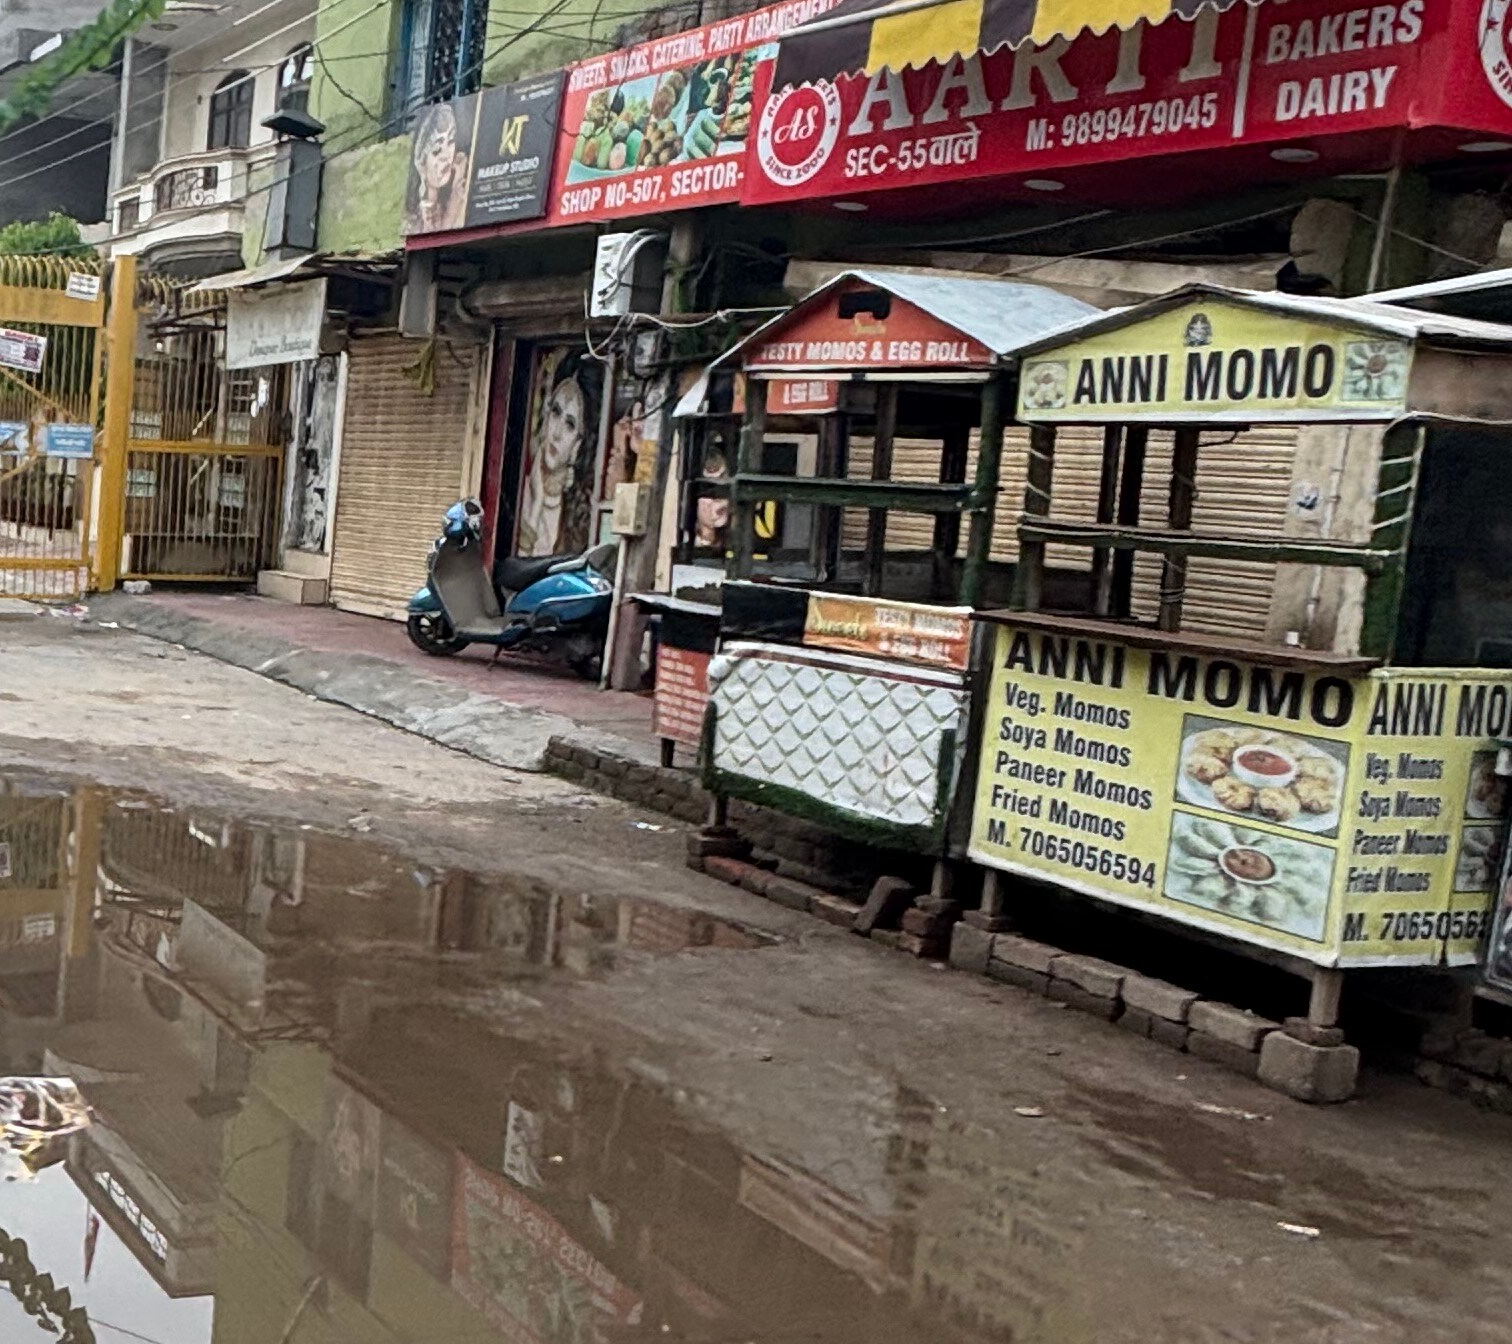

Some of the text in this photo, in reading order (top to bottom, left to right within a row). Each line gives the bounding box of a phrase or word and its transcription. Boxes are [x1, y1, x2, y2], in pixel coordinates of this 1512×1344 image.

[707, 21, 744, 54] PARTY
[1274, 66, 1398, 122] DAIRY
[774, 105, 820, 145] AS
[1025, 118, 1056, 152] M:
[1061, 92, 1220, 148] 9899479045
[560, 190, 601, 216] SHOP
[604, 176, 667, 208] NO-507,
[670, 160, 745, 198] SECTOR-
[764, 147, 826, 181] SINCE 2000
[760, 340, 970, 362] TESTY MOMOS & EGG ROLL
[1072, 342, 1336, 406] ANNI MOMO
[1003, 629, 1356, 729] ANNI MOMO
[1005, 680, 1131, 731] Veg. Momos
[1366, 682, 1512, 738] ANNI MO
[999, 716, 1132, 768] Soya Momos
[994, 750, 1154, 811] Paneer Momos
[1365, 751, 1444, 785] Veg. Momos
[991, 783, 1126, 842] Fried Momos
[1358, 790, 1442, 823] Soya Momos
[987, 817, 1157, 890] M. 7065056594
[1352, 828, 1450, 855] Paneer Momos
[1346, 866, 1432, 893] Fried Momos
[1342, 912, 1369, 942] M.
